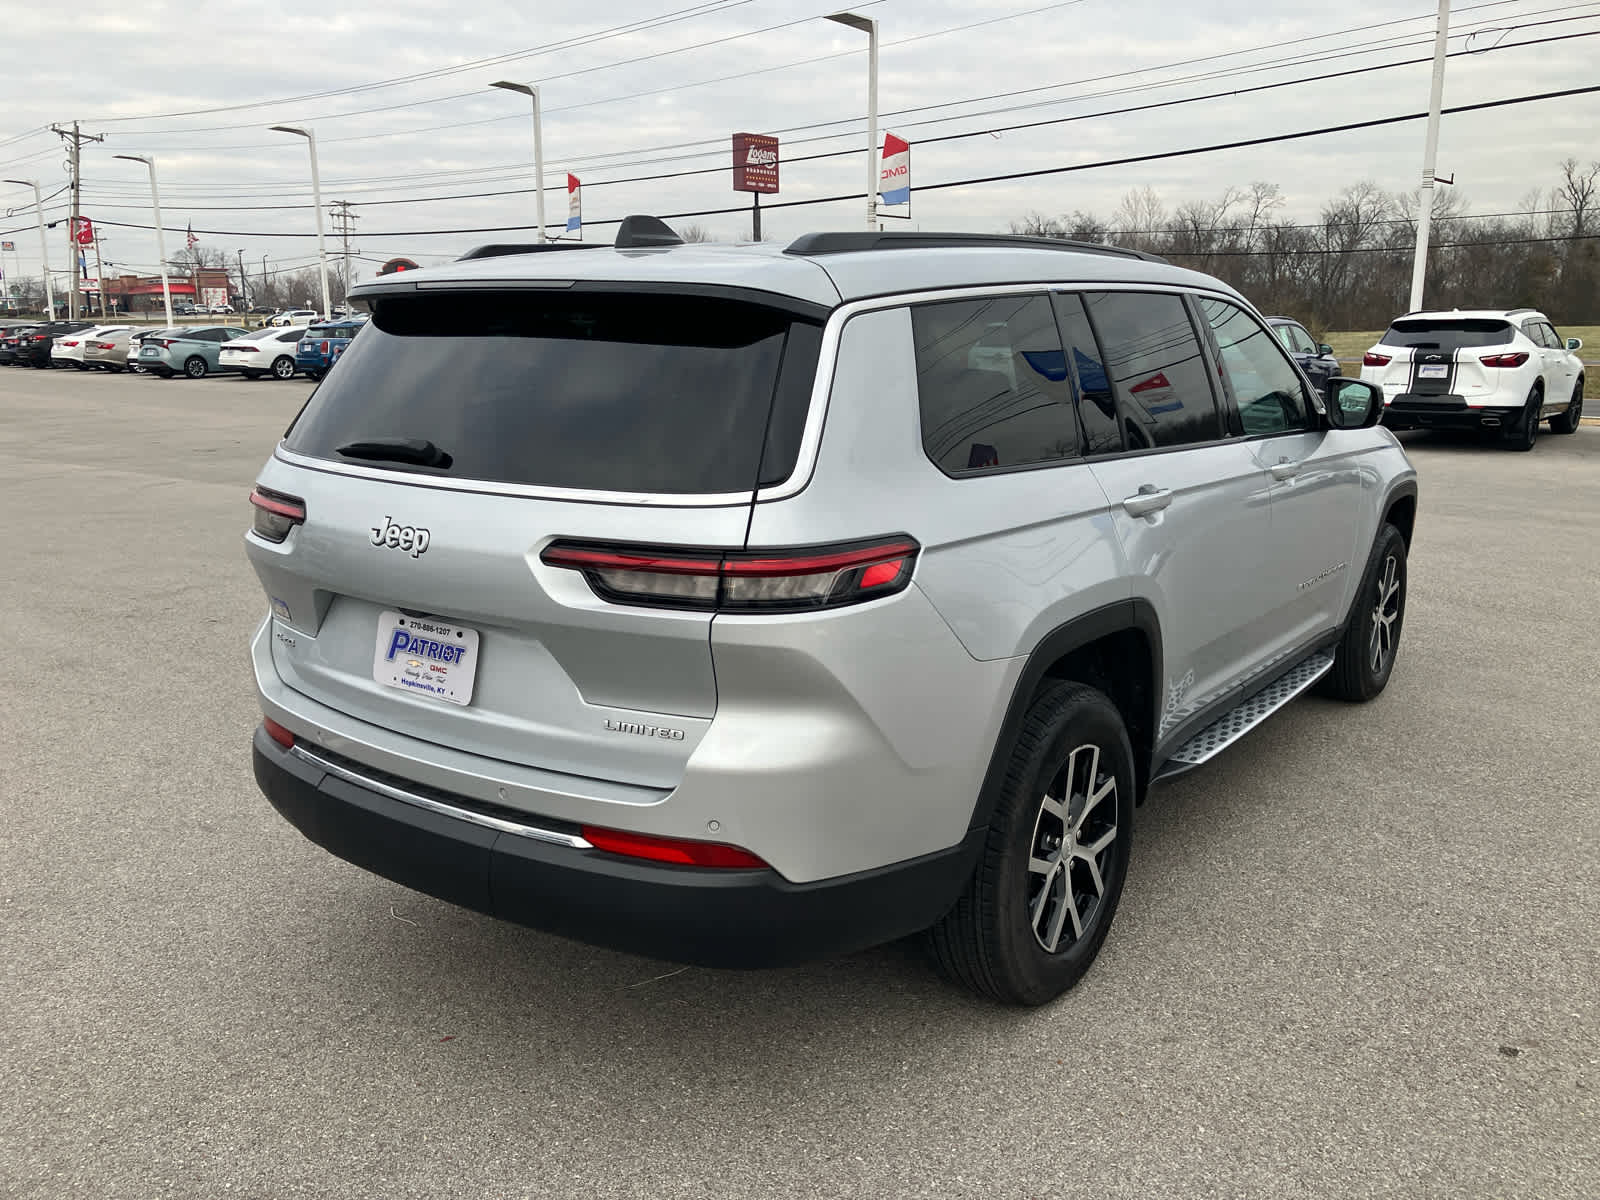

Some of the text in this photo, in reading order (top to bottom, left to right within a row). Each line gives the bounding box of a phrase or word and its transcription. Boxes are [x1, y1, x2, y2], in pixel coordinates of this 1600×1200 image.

[369, 515, 431, 559] Jeep
[410, 621, 451, 636] 270-886-1207
[386, 629, 465, 663] PATRIOT
[430, 665, 447, 675] GMC
[401, 678, 446, 695] Hopkinsville, KY
[604, 719, 685, 741] LIMITED
